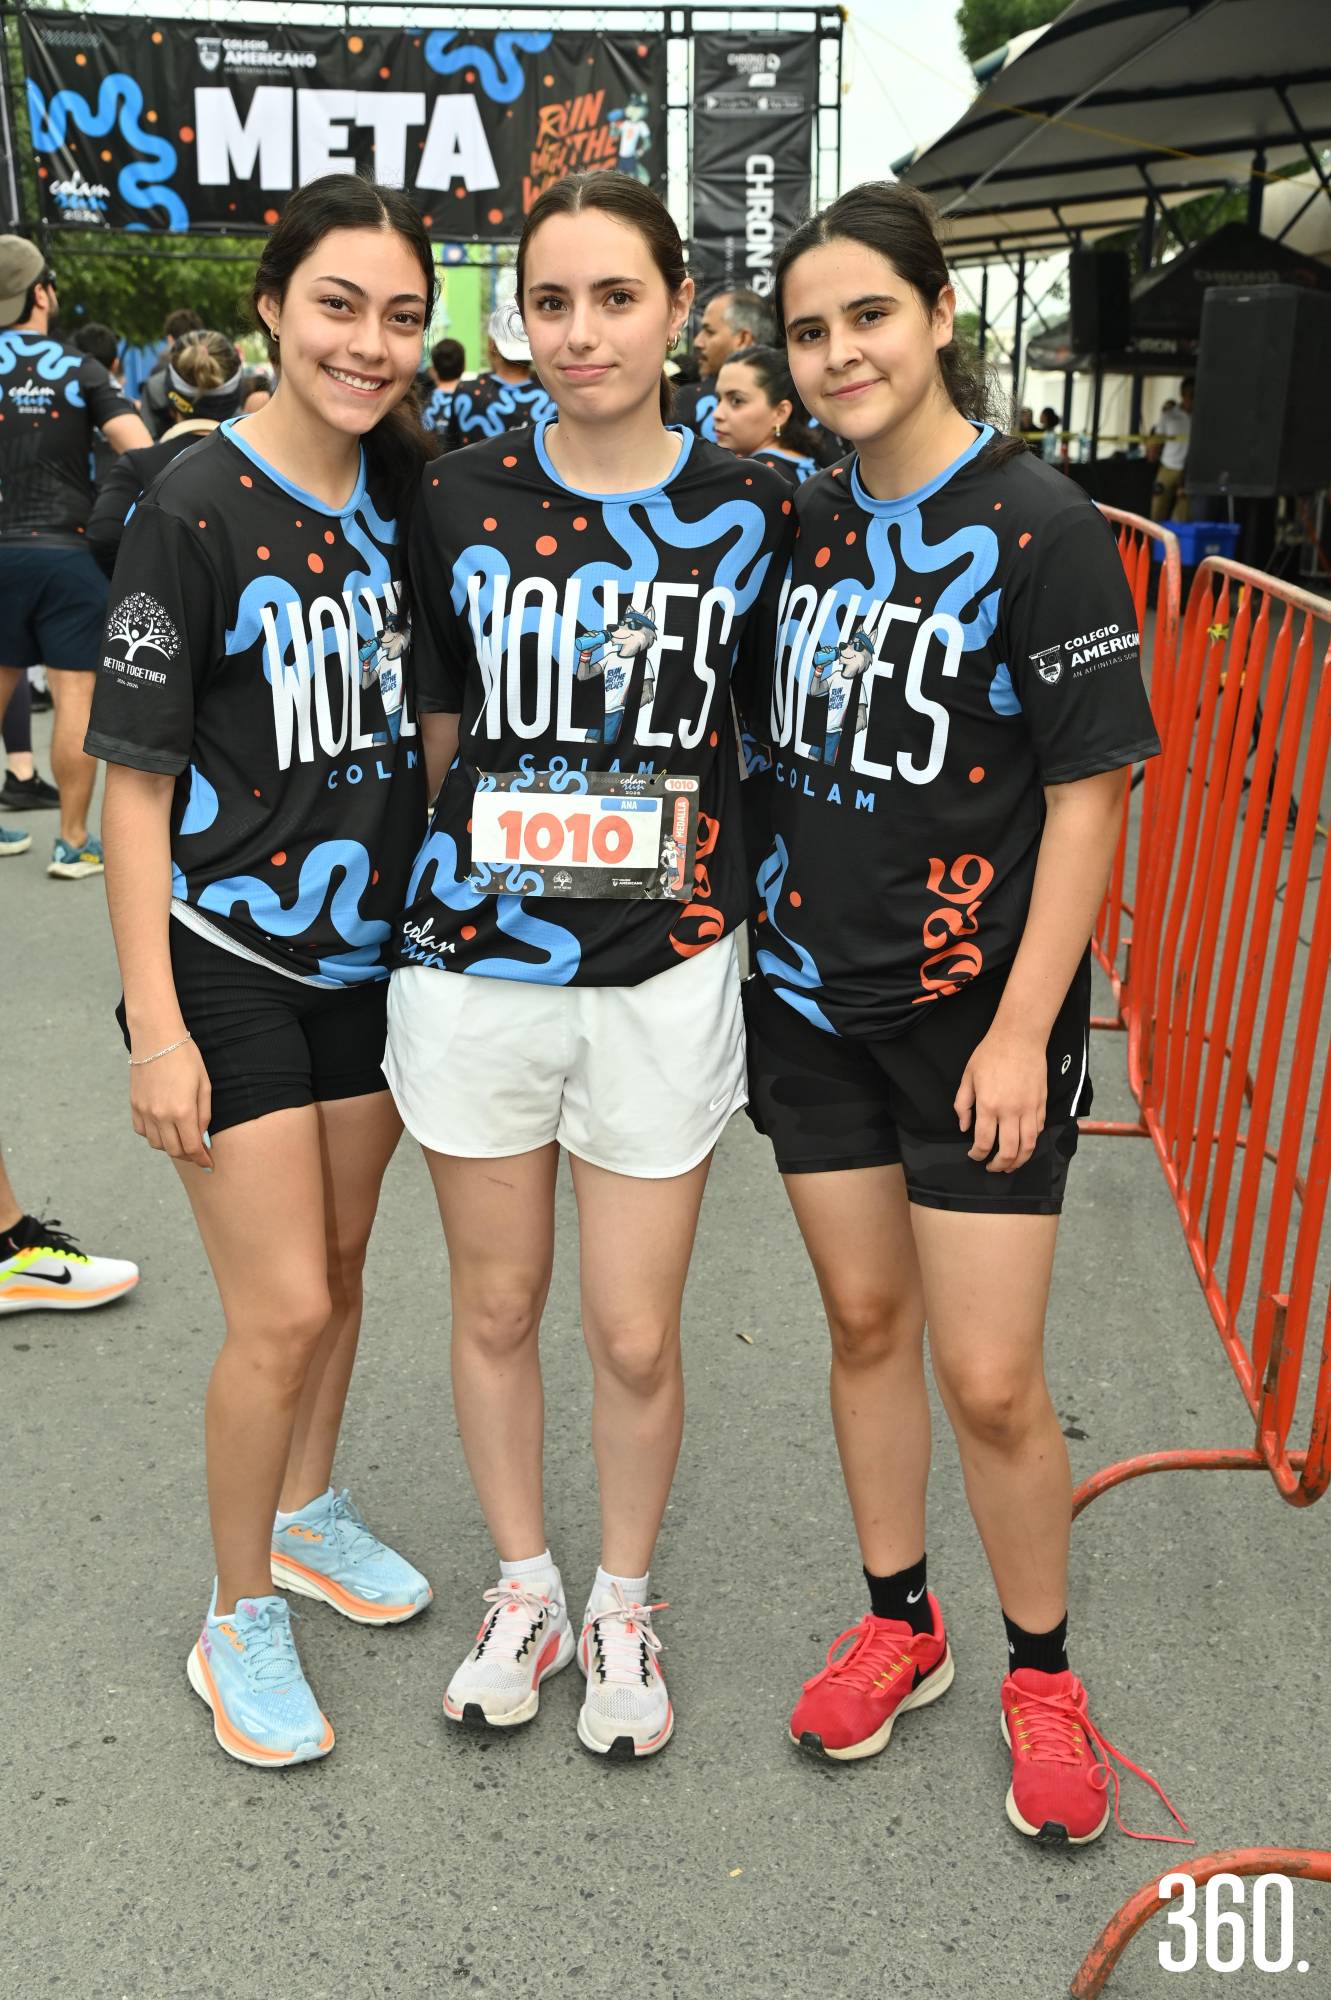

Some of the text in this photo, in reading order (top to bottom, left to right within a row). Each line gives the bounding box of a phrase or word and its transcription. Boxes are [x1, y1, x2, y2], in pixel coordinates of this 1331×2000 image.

[223, 50, 318, 69] AMERICANO
[535, 89, 606, 148] RUN
[194, 86, 500, 192] META
[1064, 623, 1119, 650] COLEGIO
[103, 656, 126, 673] BETTER
[126, 663, 167, 685] TOGETHER
[467, 574, 736, 749] WOLVES
[620, 774, 647, 785] colam
[669, 779, 694, 790] 1010
[775, 763, 876, 813] COLAM
[620, 800, 638, 810] ANA
[675, 801, 686, 838] MEDALLA
[497, 810, 634, 865] 1010
[911, 853, 995, 1004] 026
